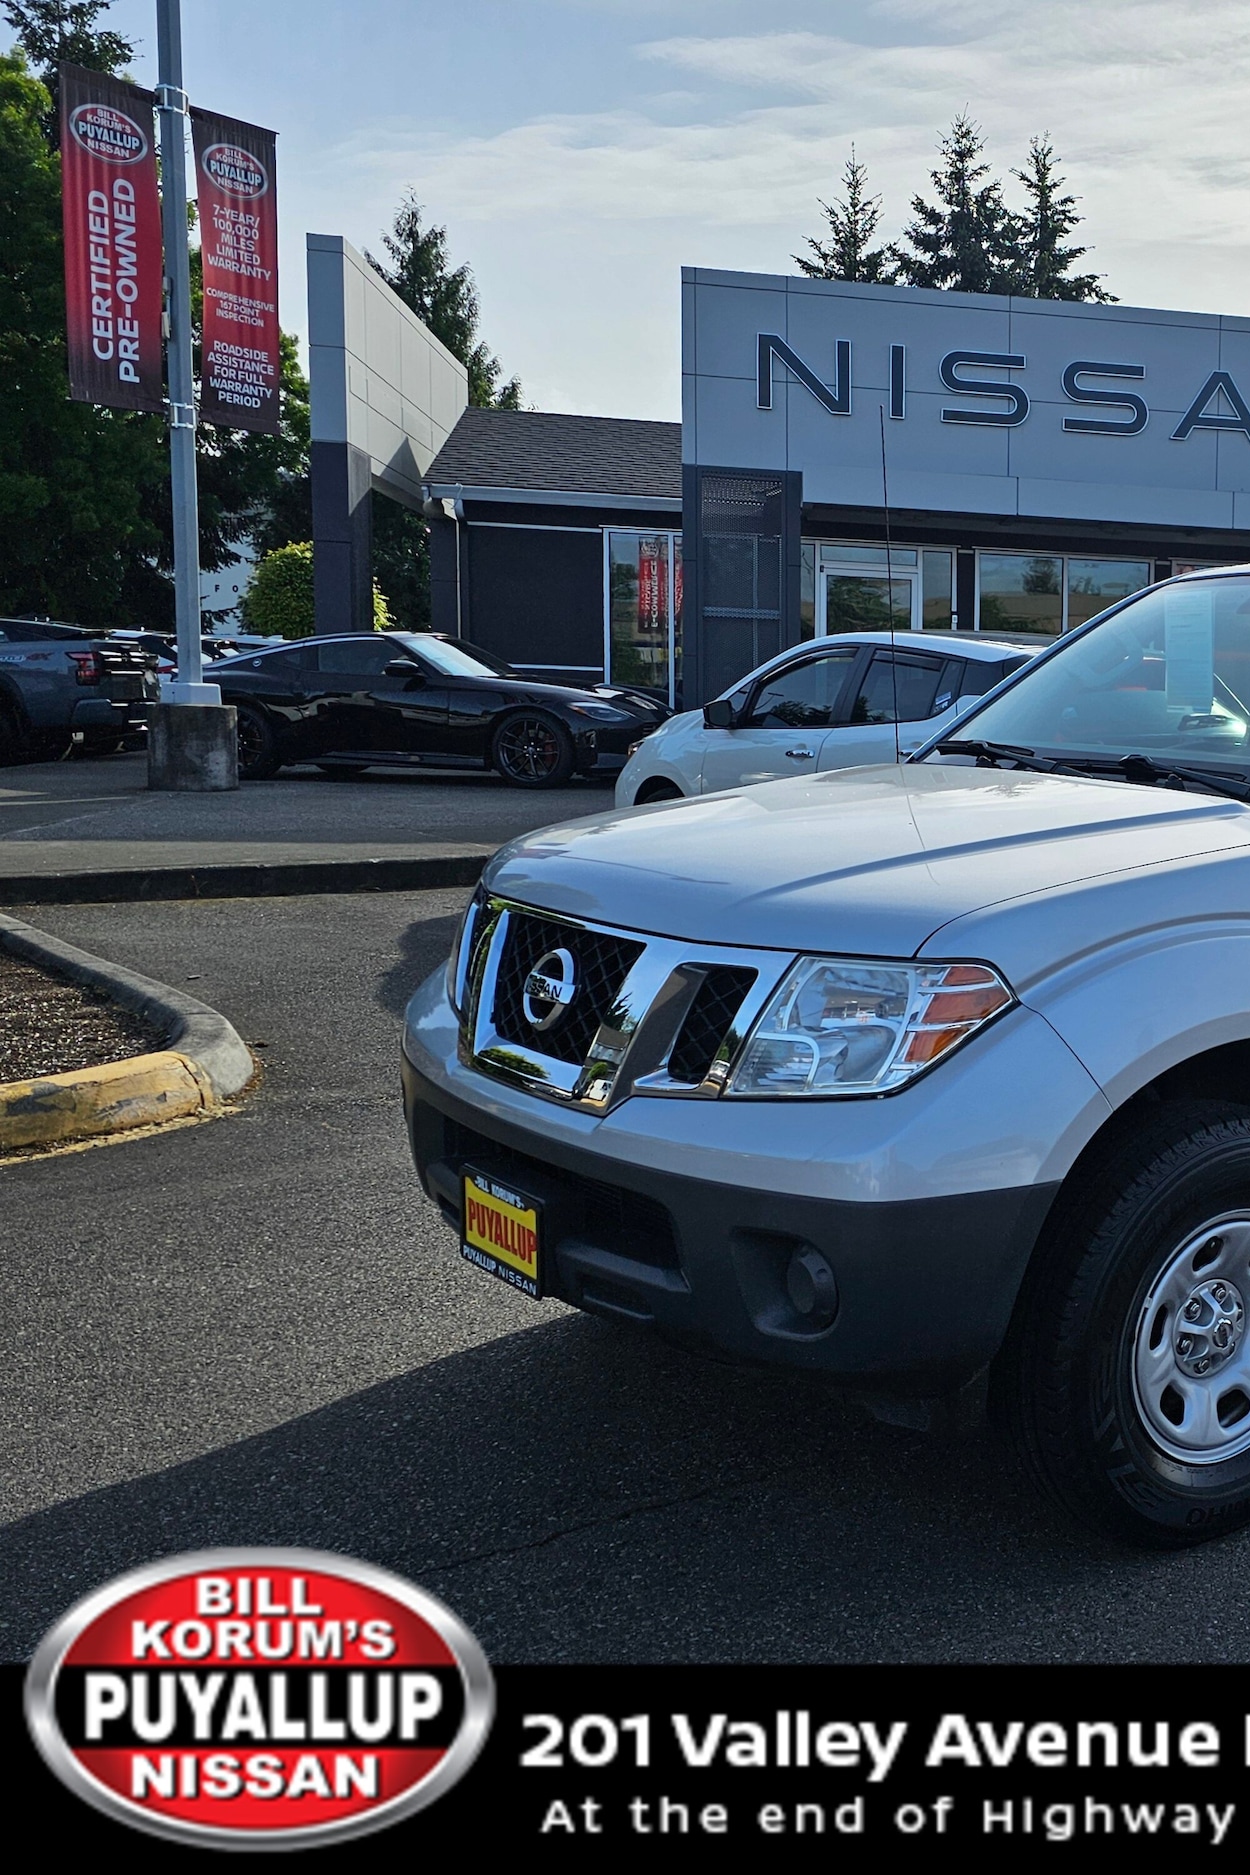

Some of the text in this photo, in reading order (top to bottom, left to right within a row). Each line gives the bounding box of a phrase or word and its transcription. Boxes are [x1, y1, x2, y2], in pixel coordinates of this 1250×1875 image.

[86, 113, 131, 134] KORUM'S
[97, 108, 118, 122] BILL
[78, 121, 140, 150] PUYALLUP
[87, 138, 130, 158] NISSAN
[224, 148, 244, 160] BILL
[210, 159, 262, 187] PUYALLUP
[216, 152, 255, 171] KORUM'S
[217, 176, 254, 194] NISSAN
[213, 203, 260, 228] 7-YEAR/
[212, 217, 259, 240] 100,000
[221, 232, 256, 252] MILES
[216, 243, 261, 266] LIMITED
[88, 190, 114, 361] CERTIFIED
[207, 253, 272, 281] WARRANTY
[112, 178, 140, 384] PRE-OWNED
[206, 287, 275, 313] COMPREHENSIVE
[233, 303, 260, 318] POINT
[216, 308, 265, 328] INSPECTION
[213, 340, 269, 362] ROADSIDE
[207, 351, 275, 376] ASSISTANCE
[214, 365, 266, 386] FOR FULL
[209, 376, 273, 399] WARRANTY
[218, 391, 261, 409] PERIOD
[467, 1197, 537, 1265] PUYALLUP
[463, 1245, 537, 1296] PUYALLUP NISSAN
